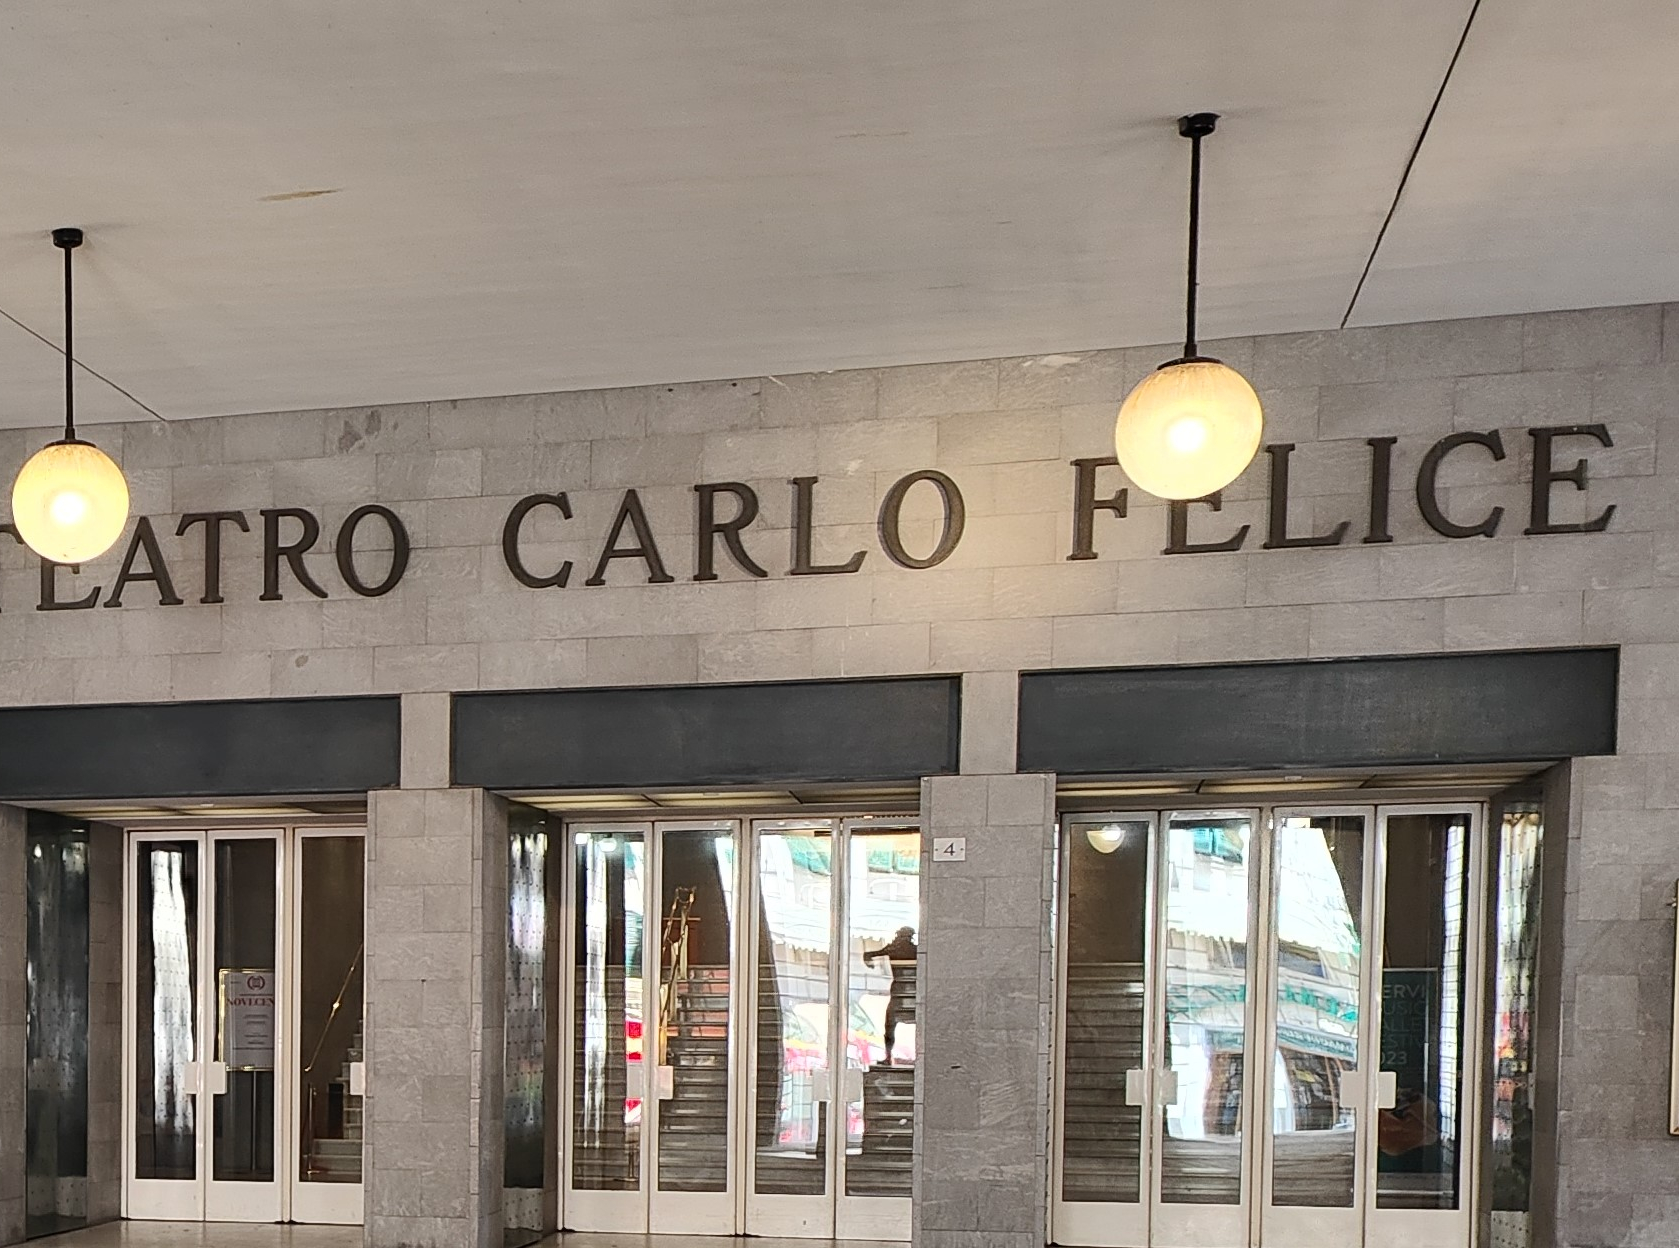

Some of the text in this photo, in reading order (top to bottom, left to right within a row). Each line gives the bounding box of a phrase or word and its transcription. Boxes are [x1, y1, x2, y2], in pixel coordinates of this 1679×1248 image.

[501, 469, 965, 589] CARLO
[1065, 423, 1617, 561] FELICE
[943, 842, 955, 857] 4
[1382, 984, 1425, 998] ERVI
[227, 997, 275, 1006] NOVECEN
[1382, 1001, 1425, 1015] USIC
